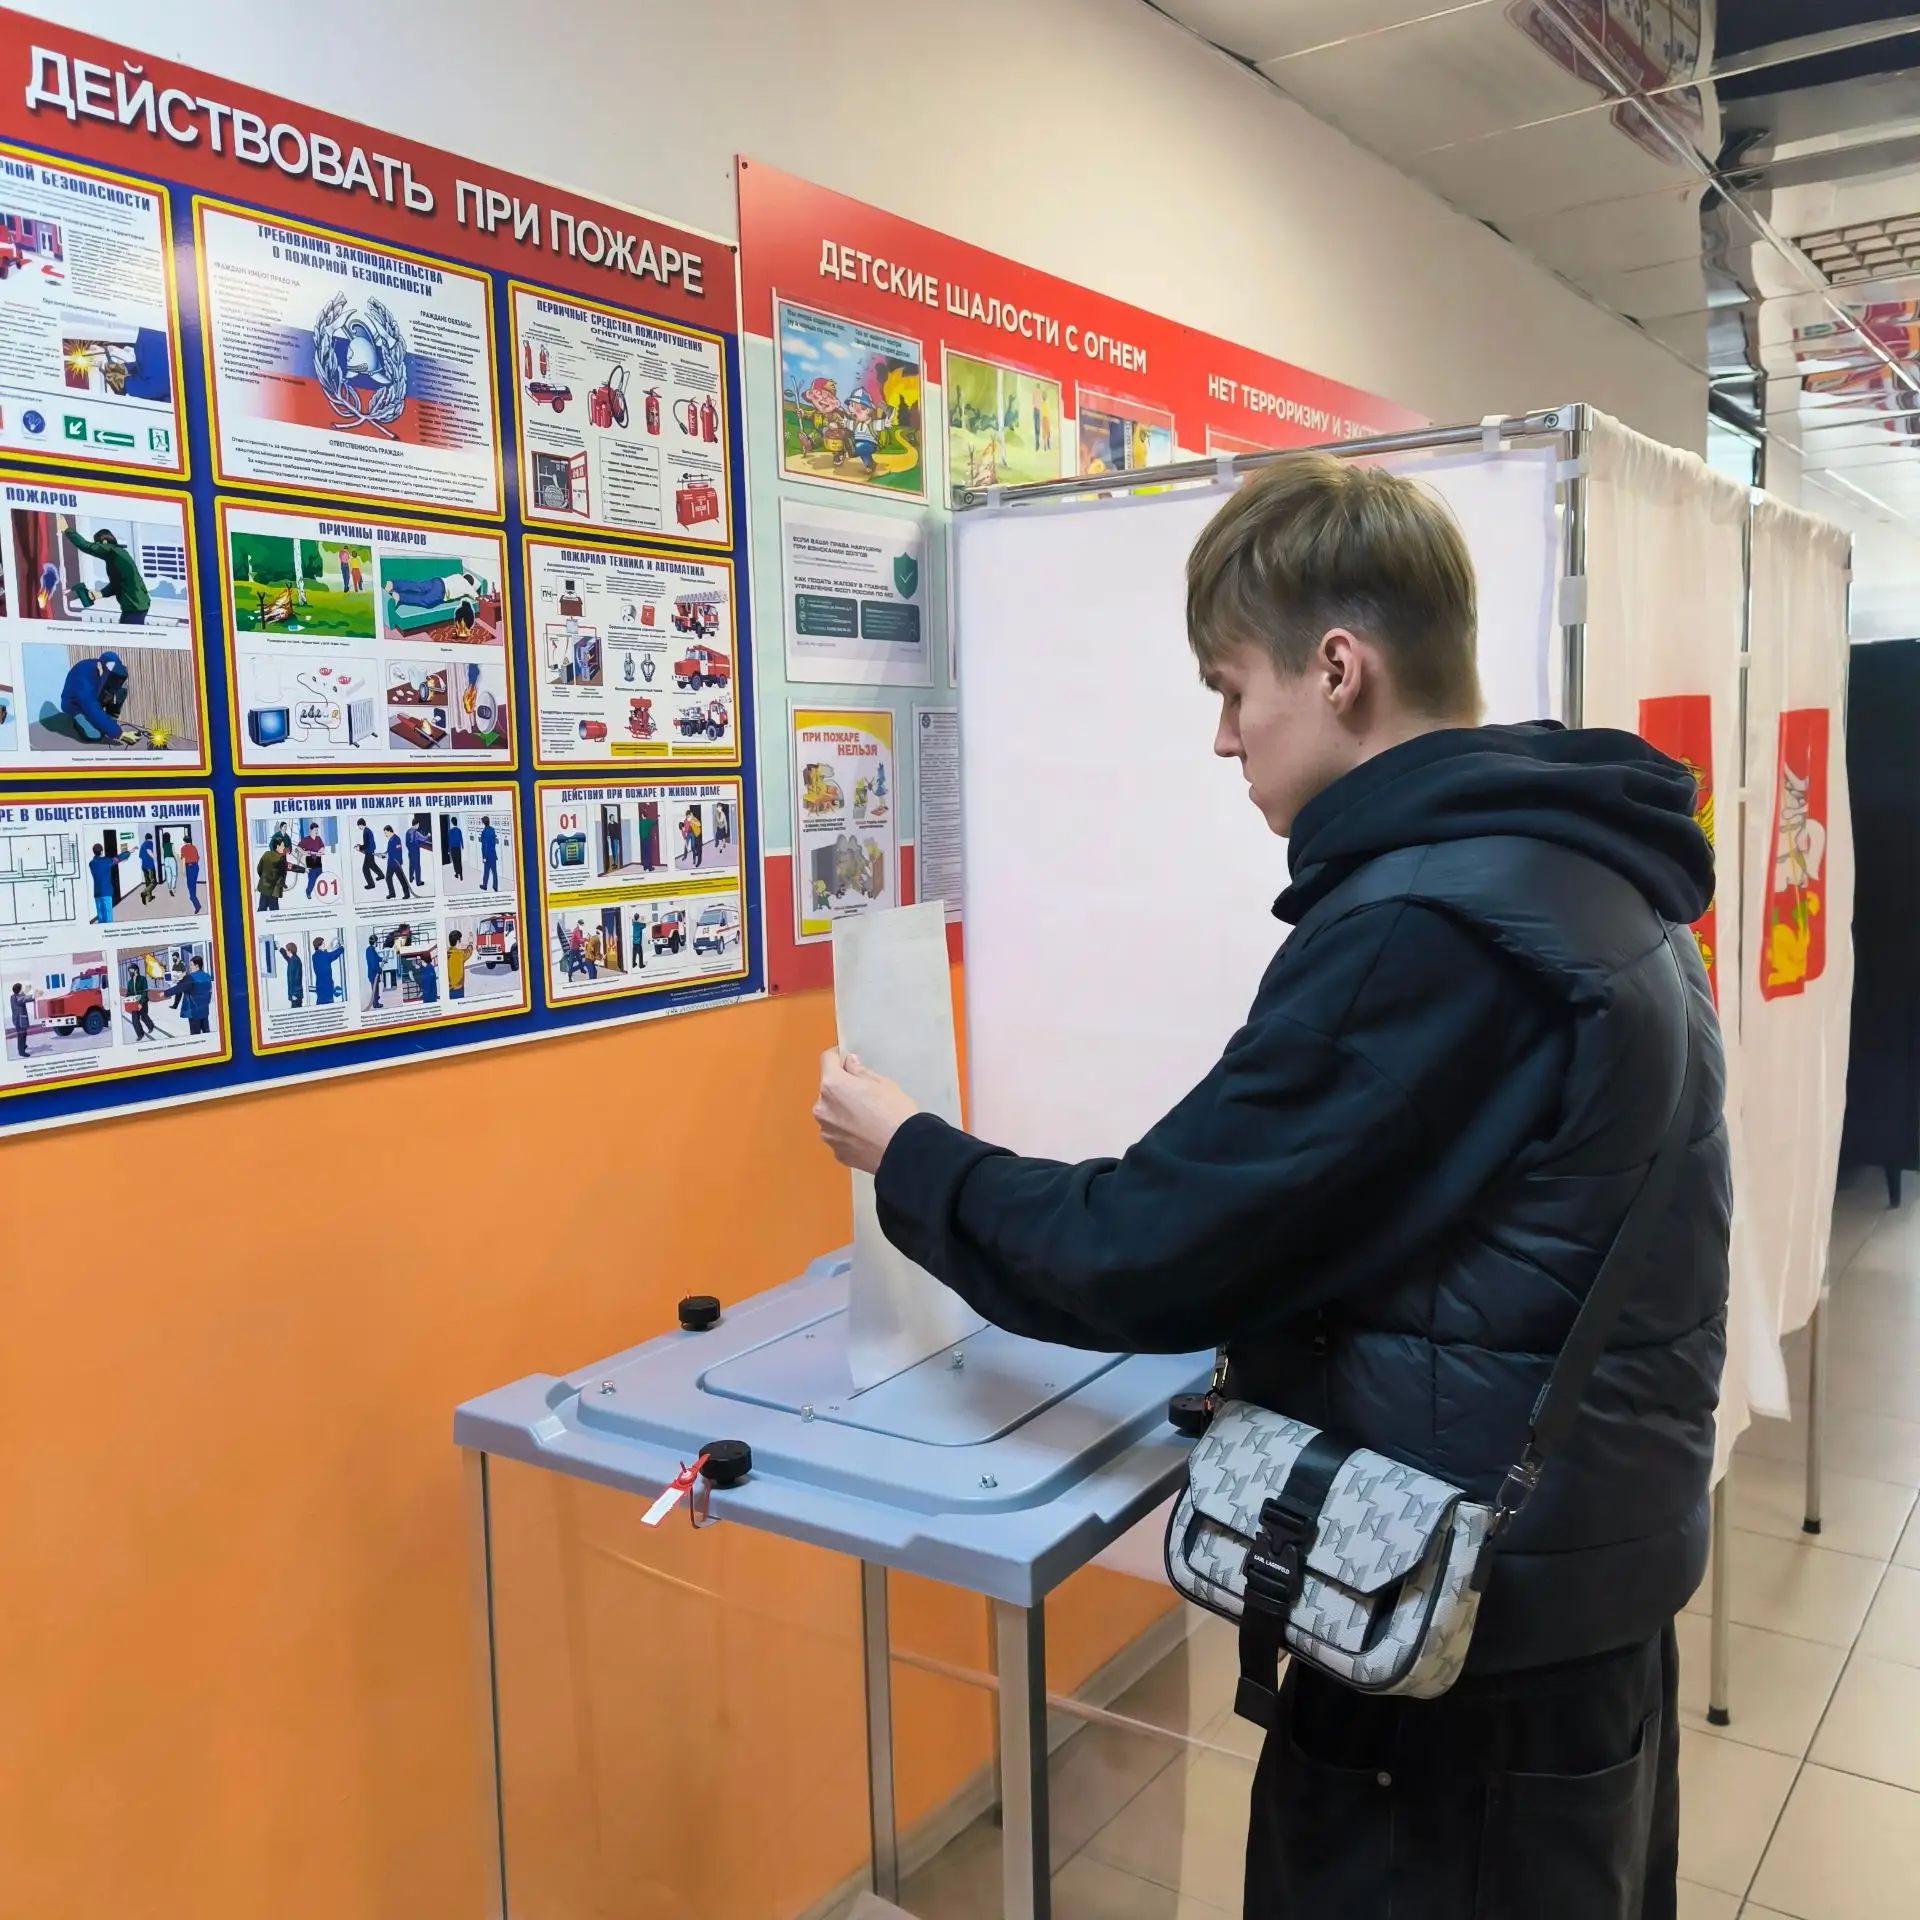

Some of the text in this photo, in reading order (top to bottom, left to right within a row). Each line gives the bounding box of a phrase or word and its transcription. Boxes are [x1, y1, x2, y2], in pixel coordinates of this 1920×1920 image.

[25, 45, 434, 212] ДЕЙСТВОВАТЬ
[455, 179, 540, 246] ПРИ
[550, 209, 704, 294] ПОЖАРЕ
[41, 170, 151, 212] БЕЗОПАСНОСТИ
[257, 225, 443, 284] ТРЕБОВАНИЯ ЗАКОНОДАТЕЛЬСТВА
[272, 246, 432, 297] О ПОЖАРНОЙ БЕЗОПАСНОСТИ
[819, 239, 1147, 374] ДЕТСКИЕ ШАЛОСТИ С ОГНЕМ
[537, 300, 588, 323] ПЕРВИЧНЫЕ
[591, 313, 632, 333] СРЕДСТВА
[635, 325, 703, 353] ПОЖАРОТУШЕНИЯ
[590, 327, 657, 348] ОГНЕТУШИТЕЛИ
[1208, 373, 1238, 404] НЕТ
[1241, 383, 1329, 432] ТЕРРОРИЗМУ
[1331, 415, 1341, 437] И
[6, 487, 77, 508] ПОЖАРОВ
[319, 521, 427, 546] ПРИЧИНЫ ПОЖАРОВ
[561, 550, 606, 566] ПОЖАРНАЯ
[609, 555, 645, 570] ТЕХНИКА
[647, 559, 653, 571] И
[655, 561, 705, 577] АВТОМАТИКА
[802, 731, 860, 742] ПРИ ПОЖАРЕ
[837, 744, 878, 756] НЕЛЬЗЯ
[273, 794, 493, 815] ДЕЙСТВИЯ ПРИ ПОЖАРЕ НА ПРЕДПРИЯТИИ
[562, 785, 721, 803] ДЕЙСТВИЯ ПРИ ПОЖАРЕ В ЖИЛОМ ДОМЕ
[20, 808, 29, 822] В
[36, 805, 146, 823] ОБЩЕСТВЕННОМ
[151, 803, 200, 819] ЗДАНИИ
[560, 813, 576, 829] 01
[317, 879, 338, 896] 01
